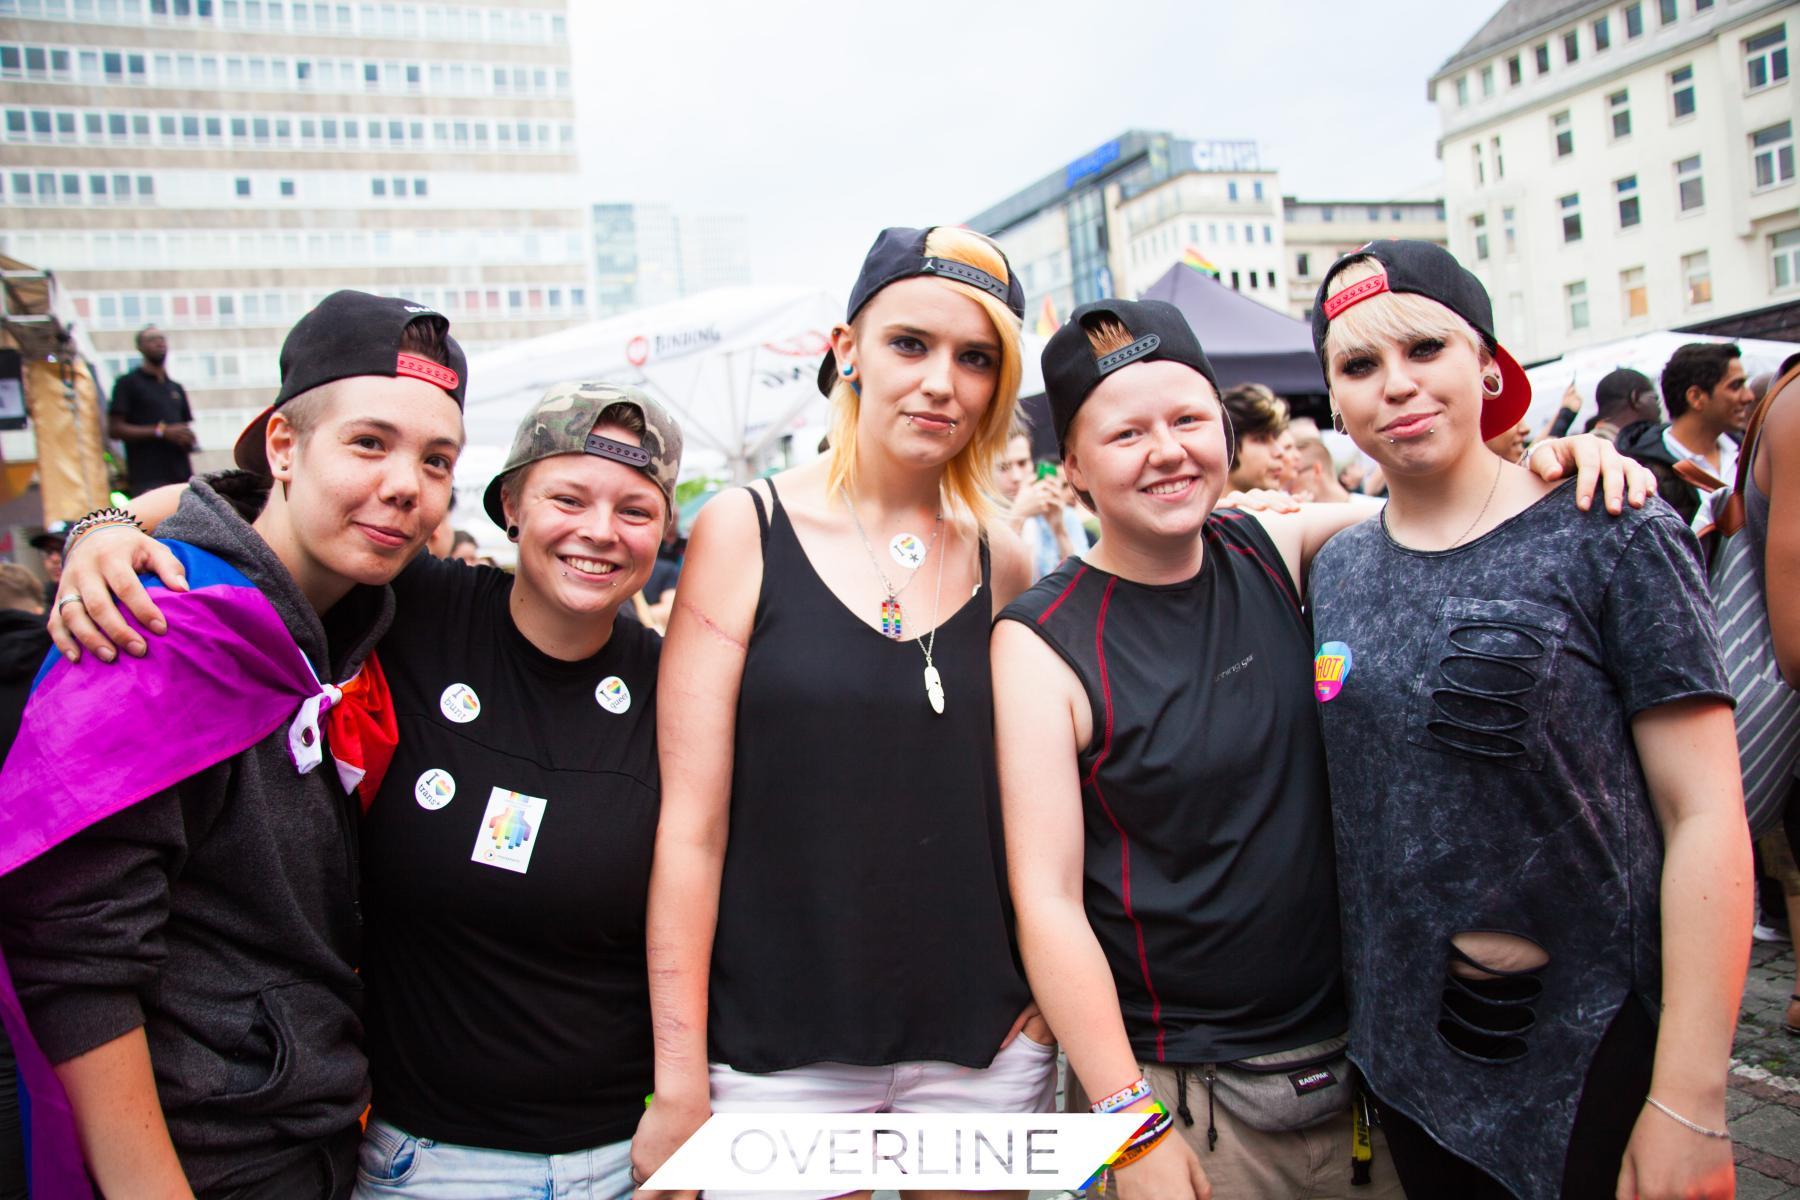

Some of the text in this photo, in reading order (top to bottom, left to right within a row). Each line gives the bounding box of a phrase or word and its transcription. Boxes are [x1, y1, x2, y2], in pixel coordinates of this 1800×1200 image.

[1315, 656, 1342, 679] HOT
[452, 685, 466, 698] I
[425, 772, 440, 786] I
[1298, 1071, 1329, 1086] EASTPAK
